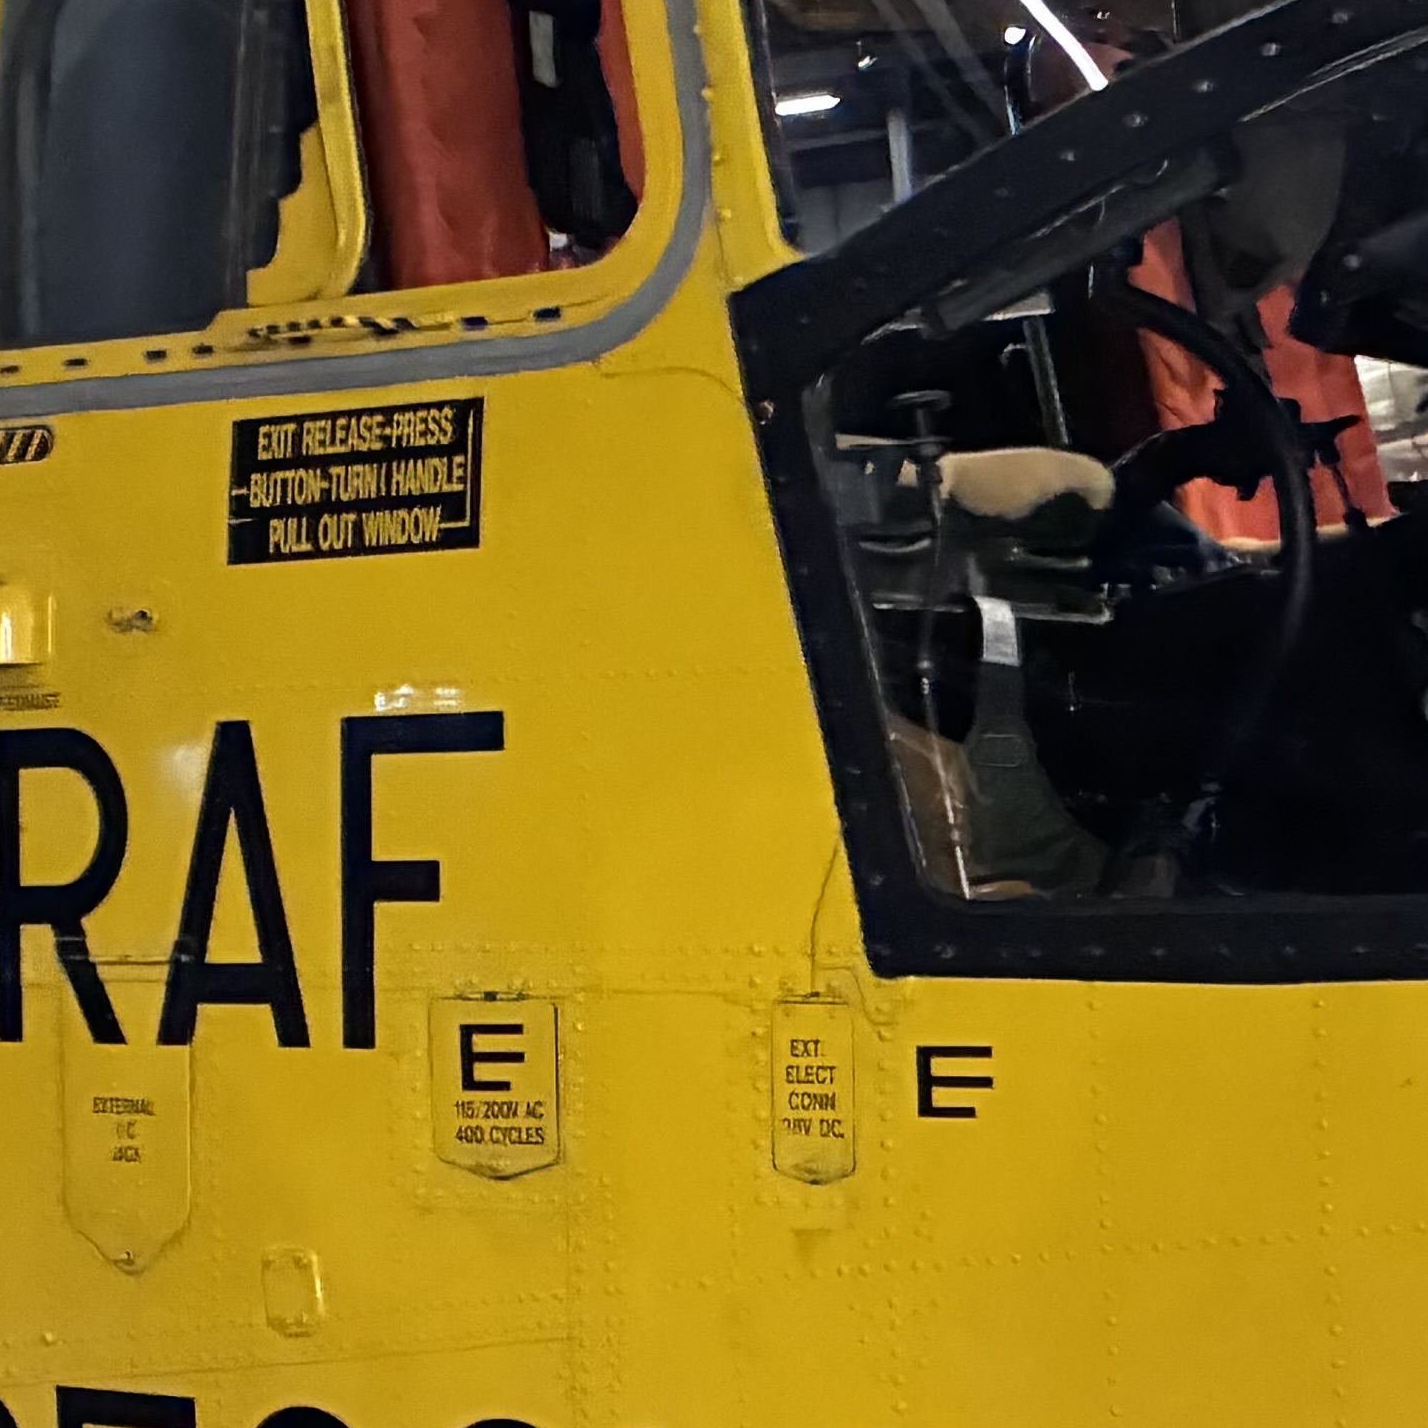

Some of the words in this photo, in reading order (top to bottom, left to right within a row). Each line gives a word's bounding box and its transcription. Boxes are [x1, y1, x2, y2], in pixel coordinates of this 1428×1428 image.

[258, 423, 298, 461] EXIT
[391, 454, 465, 496] HANDLE
[268, 517, 315, 554] PULL
[318, 512, 357, 551] OUT
[362, 505, 442, 548] WINDOW
[459, 1024, 525, 1091] E
[785, 1065, 836, 1084] ELECT
[788, 1090, 836, 1111] CONN
[915, 1046, 994, 1118] E
[456, 1125, 484, 1143] 400
[489, 1126, 545, 1146] CYCLES
